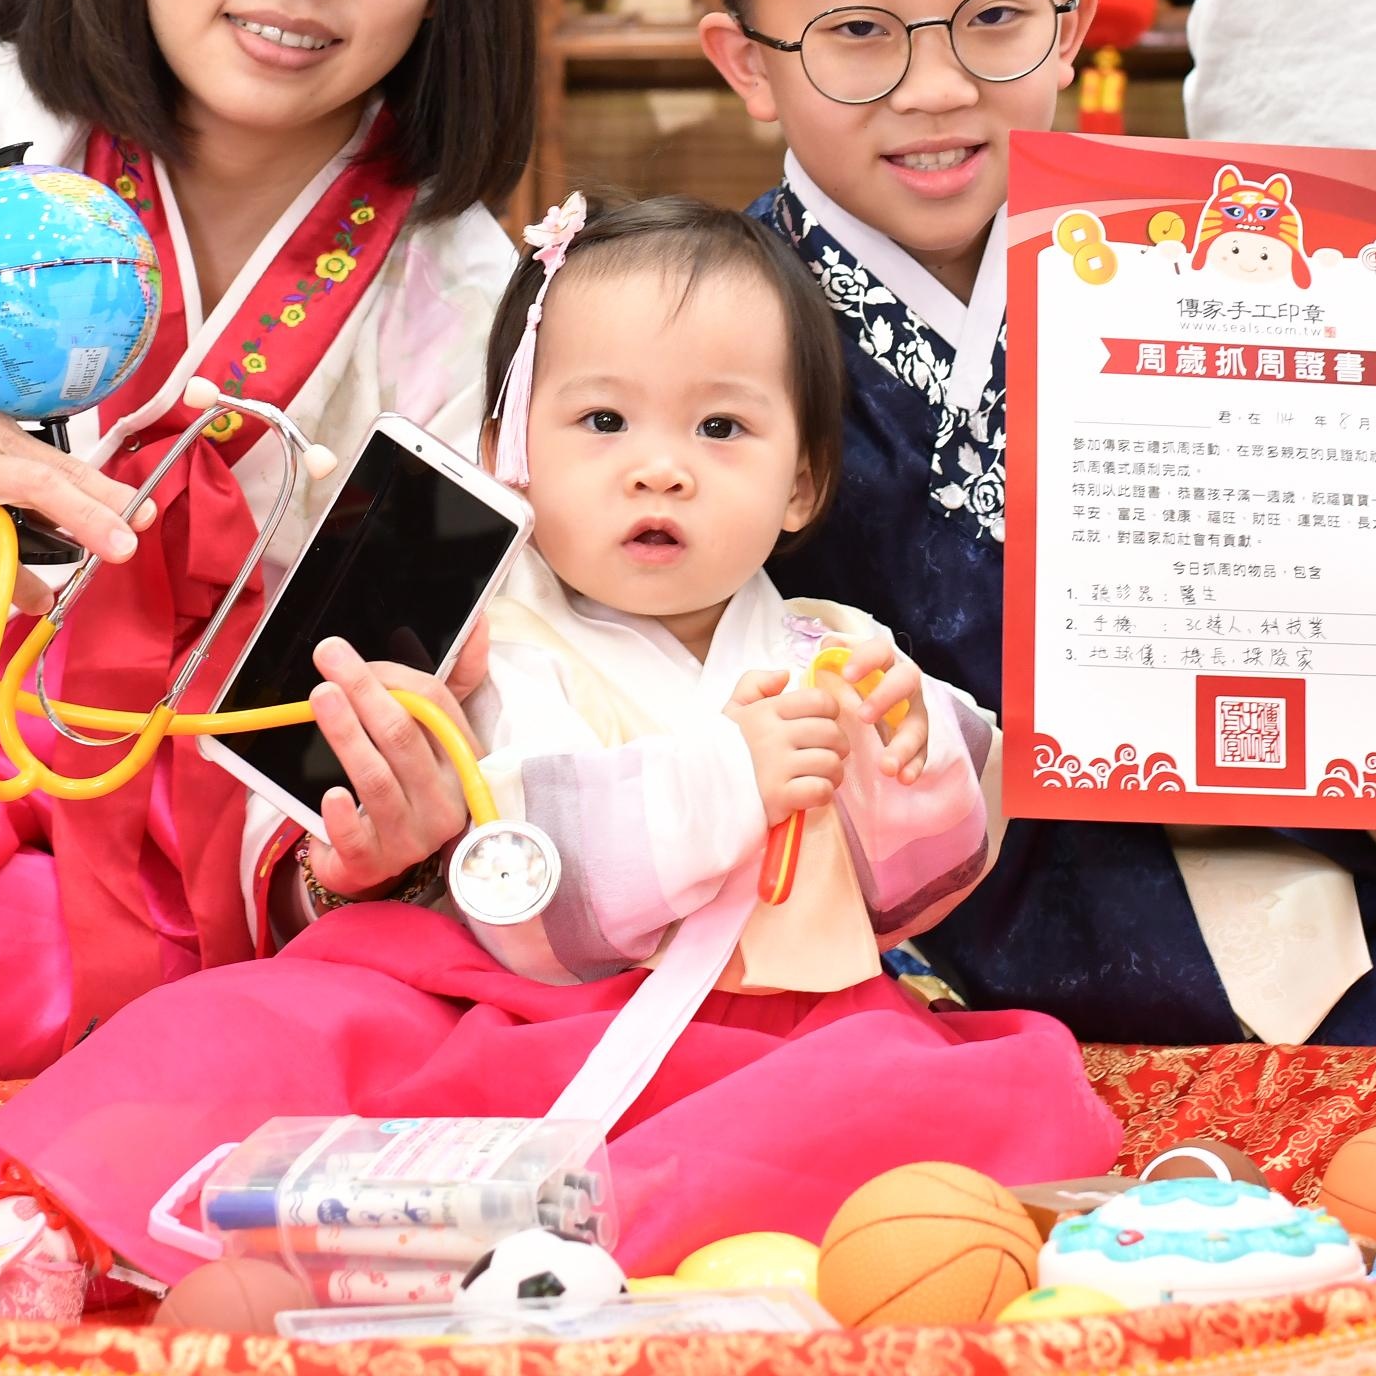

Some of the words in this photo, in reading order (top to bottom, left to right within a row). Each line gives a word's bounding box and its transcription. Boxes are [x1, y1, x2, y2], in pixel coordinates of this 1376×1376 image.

[1176, 297, 1326, 324] 傳家手工印章
[1179, 321, 1322, 337] www.seals.com.tw
[1135, 342, 1366, 384] 周歲抓周證書
